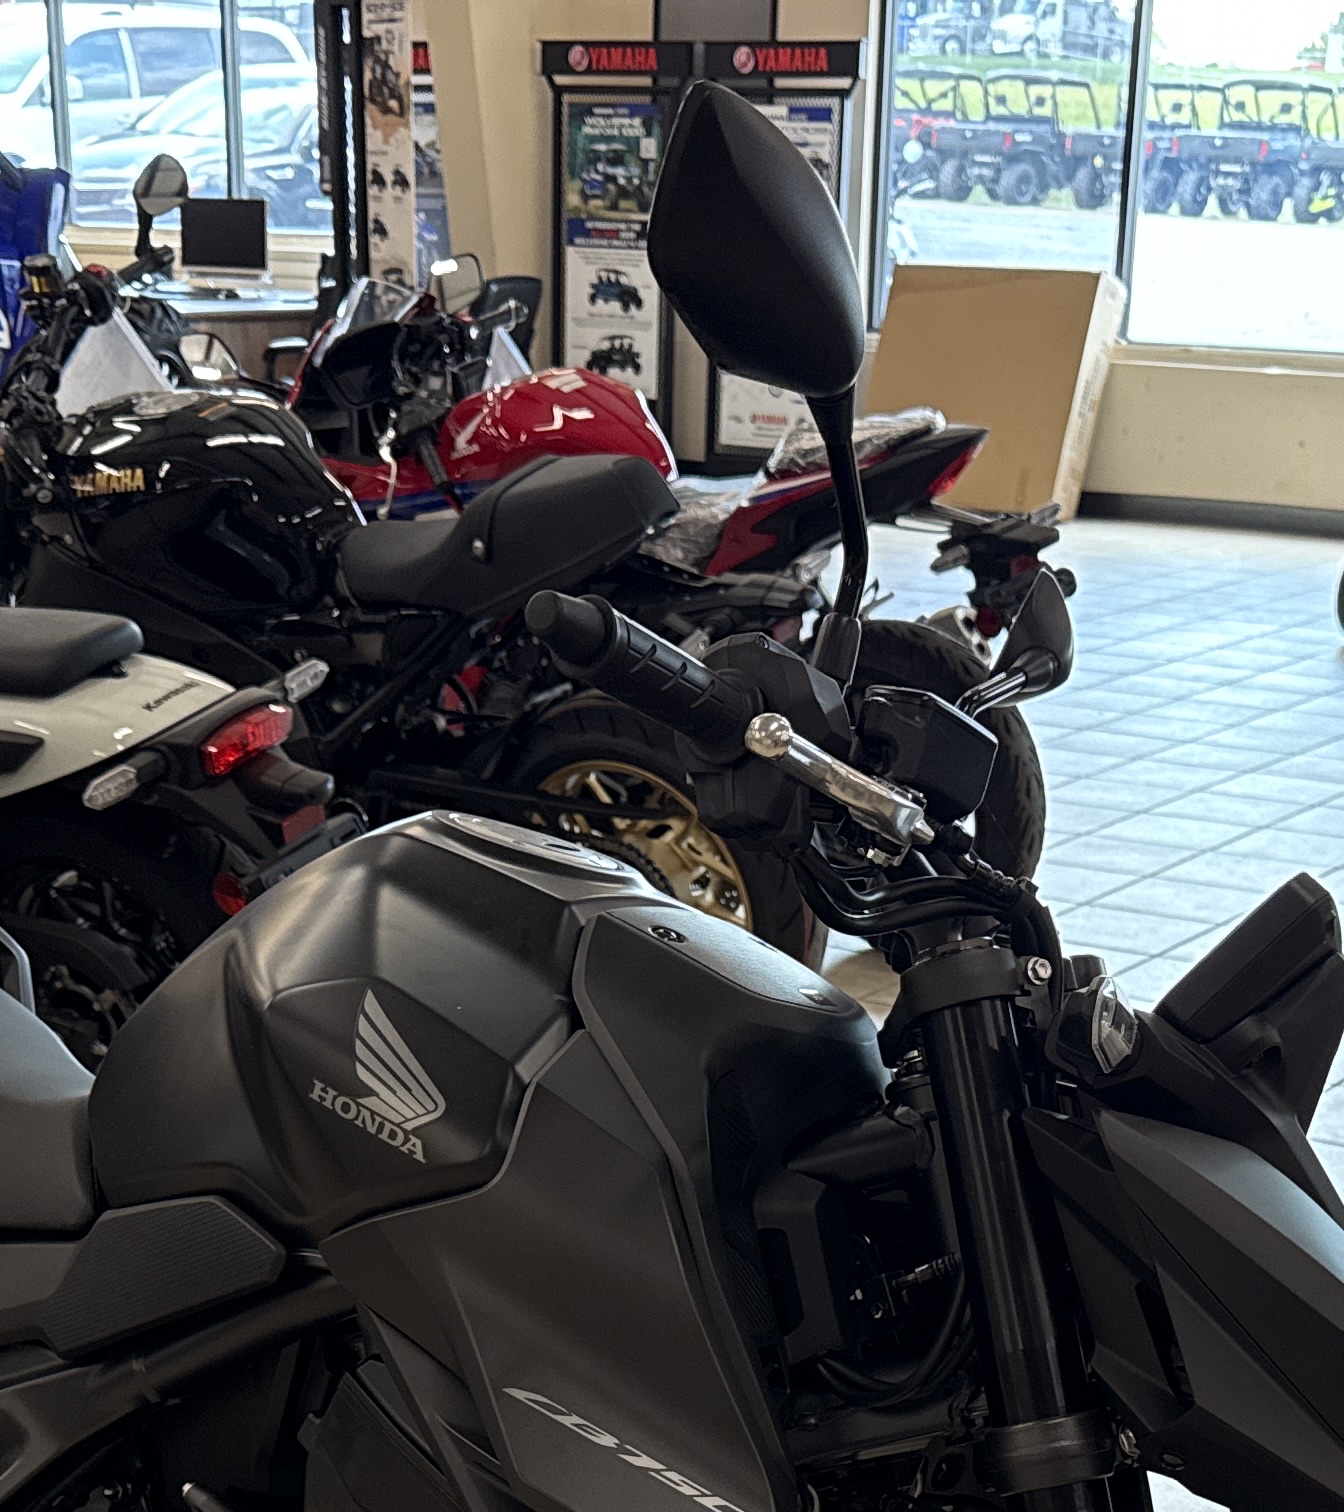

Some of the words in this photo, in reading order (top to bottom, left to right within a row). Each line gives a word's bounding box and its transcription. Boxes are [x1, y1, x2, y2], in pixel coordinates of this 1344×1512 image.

[589, 47, 658, 71] YAMAHA
[756, 47, 829, 71] YAMAHA
[70, 467, 145, 498] YAMAHA
[309, 1079, 427, 1164] HONDA
